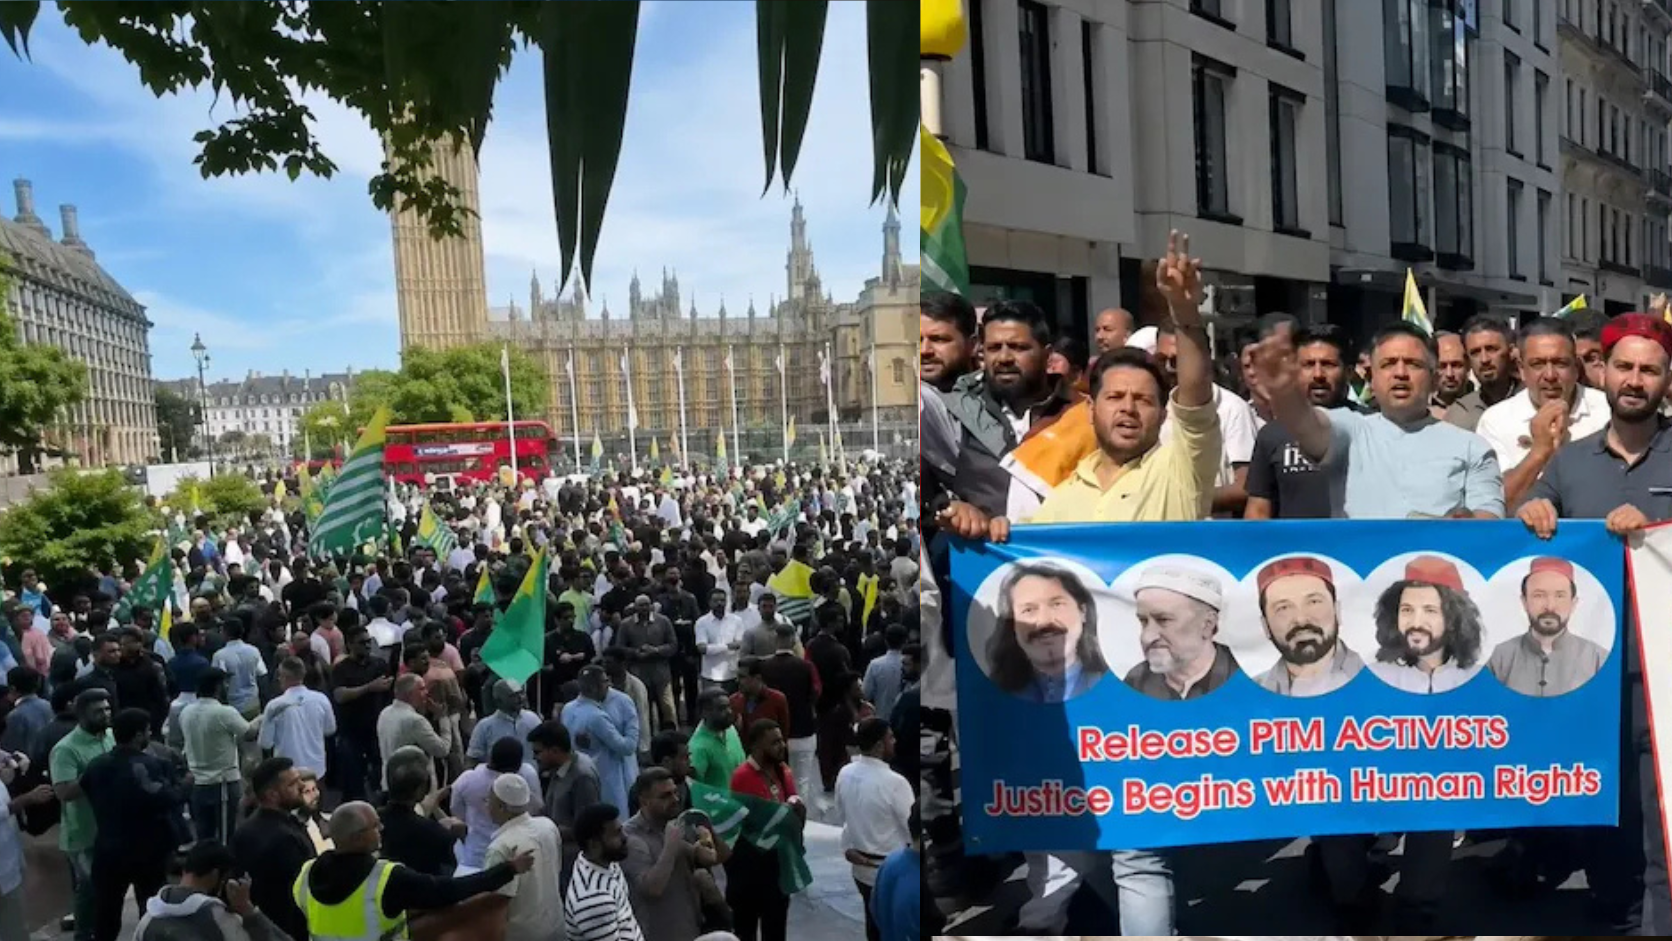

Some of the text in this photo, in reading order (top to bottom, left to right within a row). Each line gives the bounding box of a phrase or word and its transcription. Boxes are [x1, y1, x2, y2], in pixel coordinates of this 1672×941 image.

[1078, 715, 1509, 762] Release PTM ACTIVISTS
[985, 763, 1602, 820] Justice Begins with Human Rights
